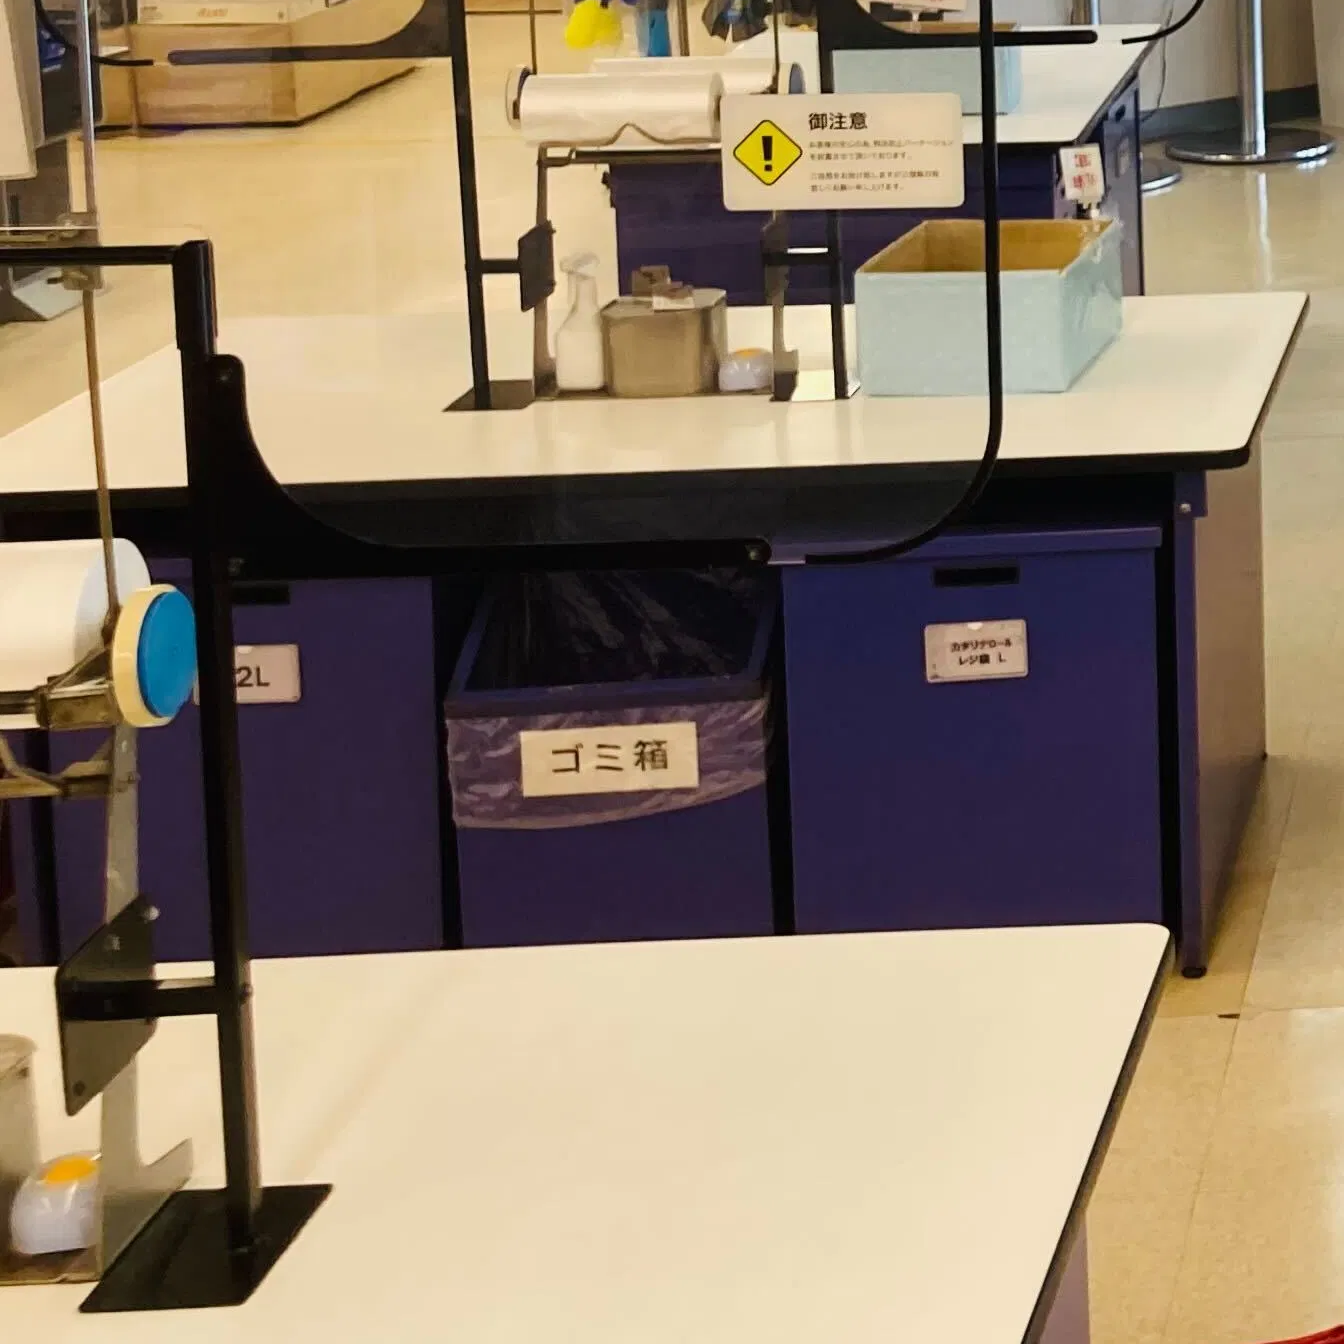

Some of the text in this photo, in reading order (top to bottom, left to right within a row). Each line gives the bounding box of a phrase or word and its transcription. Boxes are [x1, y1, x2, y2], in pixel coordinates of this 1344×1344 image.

[808, 111, 868, 131] 御注意
[551, 738, 669, 775] ゴミ箱
